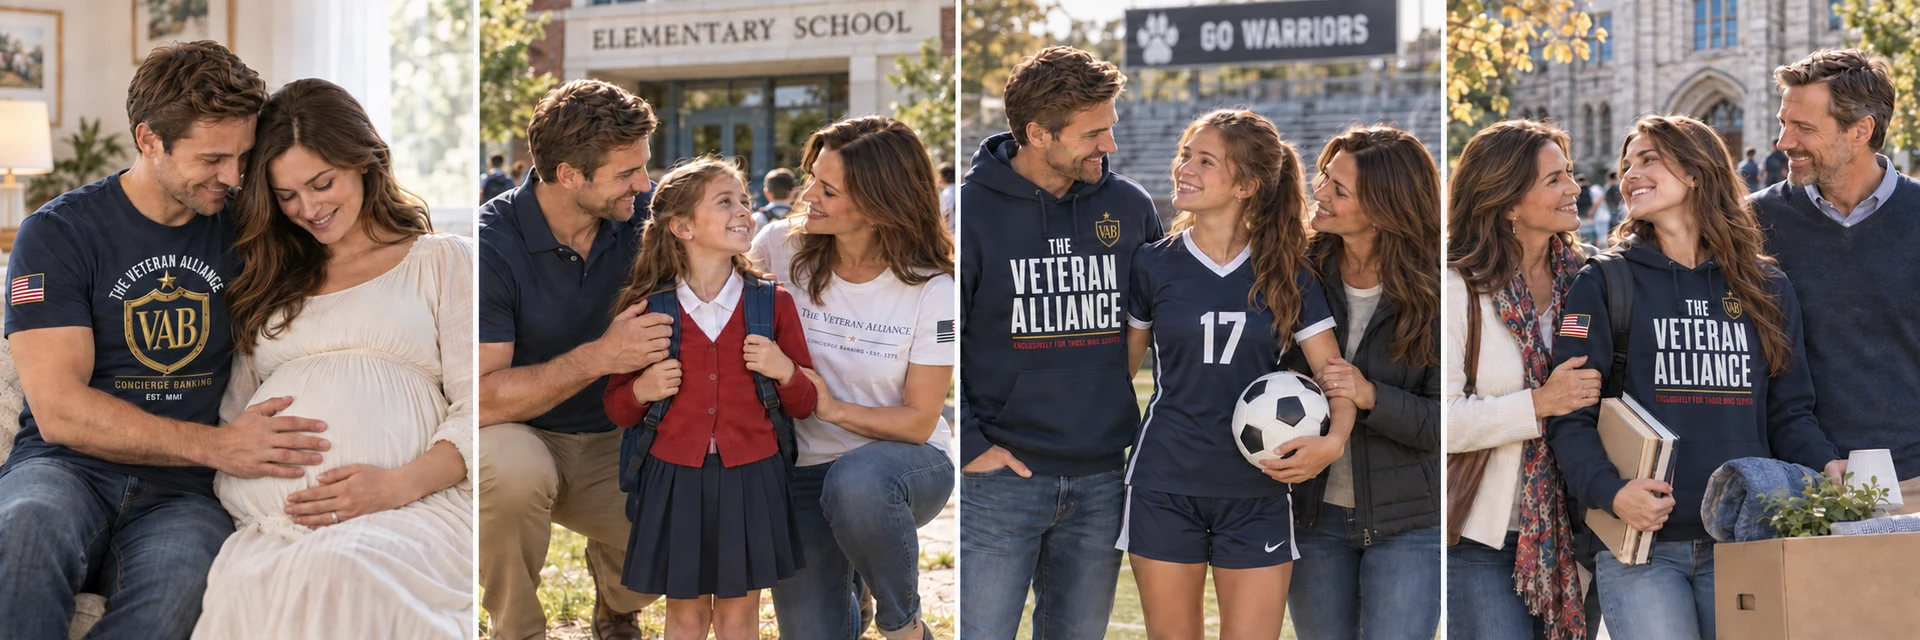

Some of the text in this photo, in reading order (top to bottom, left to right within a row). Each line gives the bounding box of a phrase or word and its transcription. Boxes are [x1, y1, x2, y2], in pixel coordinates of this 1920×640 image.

[592, 10, 912, 50] ELEMENTARY SCHOOL
[1200, 14, 1369, 51] GO WARRIORS
[1048, 237, 1072, 255] THE
[1098, 225, 1118, 239] VAB
[108, 254, 225, 300] THE VETERAN ALLIANCE
[1010, 254, 1118, 295] VETERAN
[1011, 292, 1121, 334] ALLIANCE
[1685, 299, 1709, 316] THE
[136, 307, 198, 350] VAB
[1200, 311, 1247, 364] 17
[1653, 318, 1748, 352] VETERAN
[115, 377, 213, 390] CONCIERGE BANKING
[1654, 351, 1752, 388] ALLIANCE
[145, 393, 183, 401] EST. MMI
